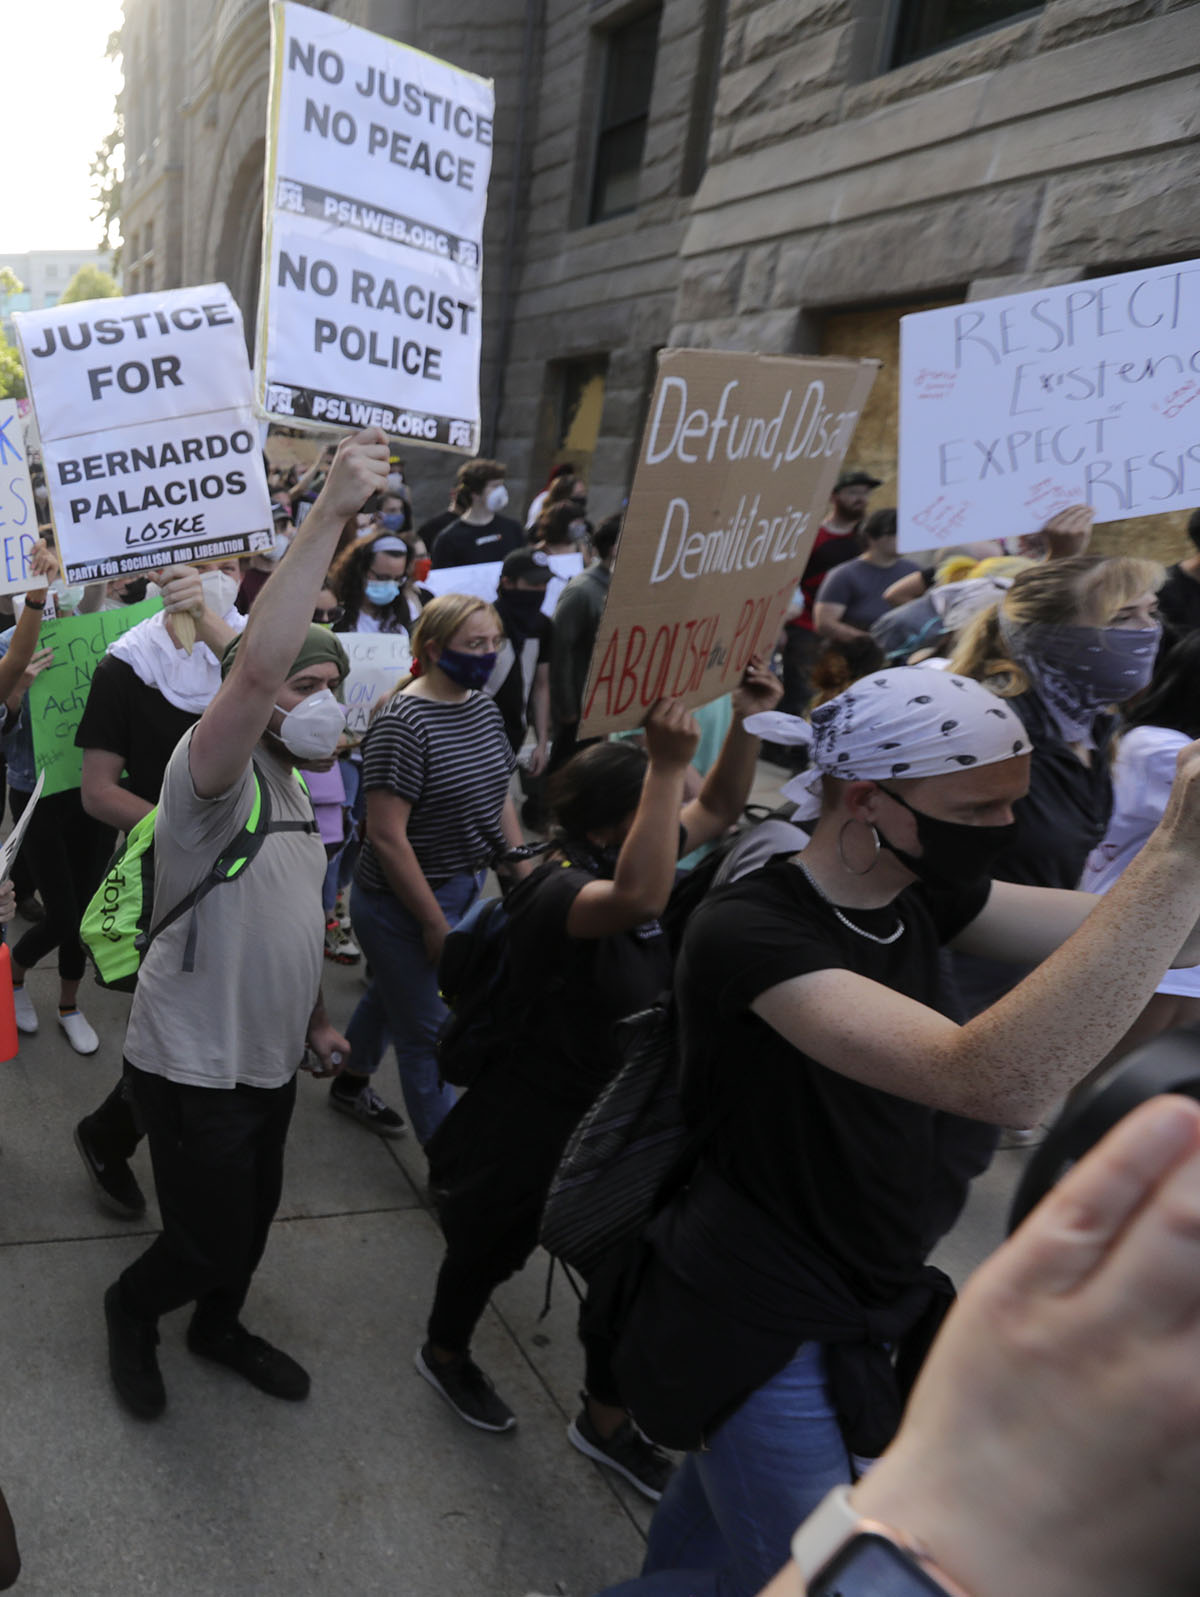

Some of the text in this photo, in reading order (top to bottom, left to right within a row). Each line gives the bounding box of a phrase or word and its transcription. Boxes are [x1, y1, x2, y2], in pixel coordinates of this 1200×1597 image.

[288, 37, 493, 147] NO JUSTICE
[304, 98, 475, 191] NO PEACE
[323, 196, 448, 255] PSLWEB.ORG
[278, 251, 475, 335] NO RACIST
[954, 268, 1200, 369] RESPECT
[31, 303, 234, 358] JUSTICE
[314, 318, 442, 381] POLICE
[87, 355, 183, 400] FOR
[312, 396, 438, 440] PSLWEB.ORG
[57, 430, 254, 485] BERNARDO
[939, 415, 1120, 487] EXPECT
[69, 471, 247, 523] PALACIOS
[125, 513, 206, 545] LOSKE
[68, 565, 100, 582] PARTY
[100, 562, 119, 576] FOR
[120, 551, 172, 572] SOCIALISM
[174, 547, 193, 562] AND
[194, 538, 245, 559] LIBERATION
